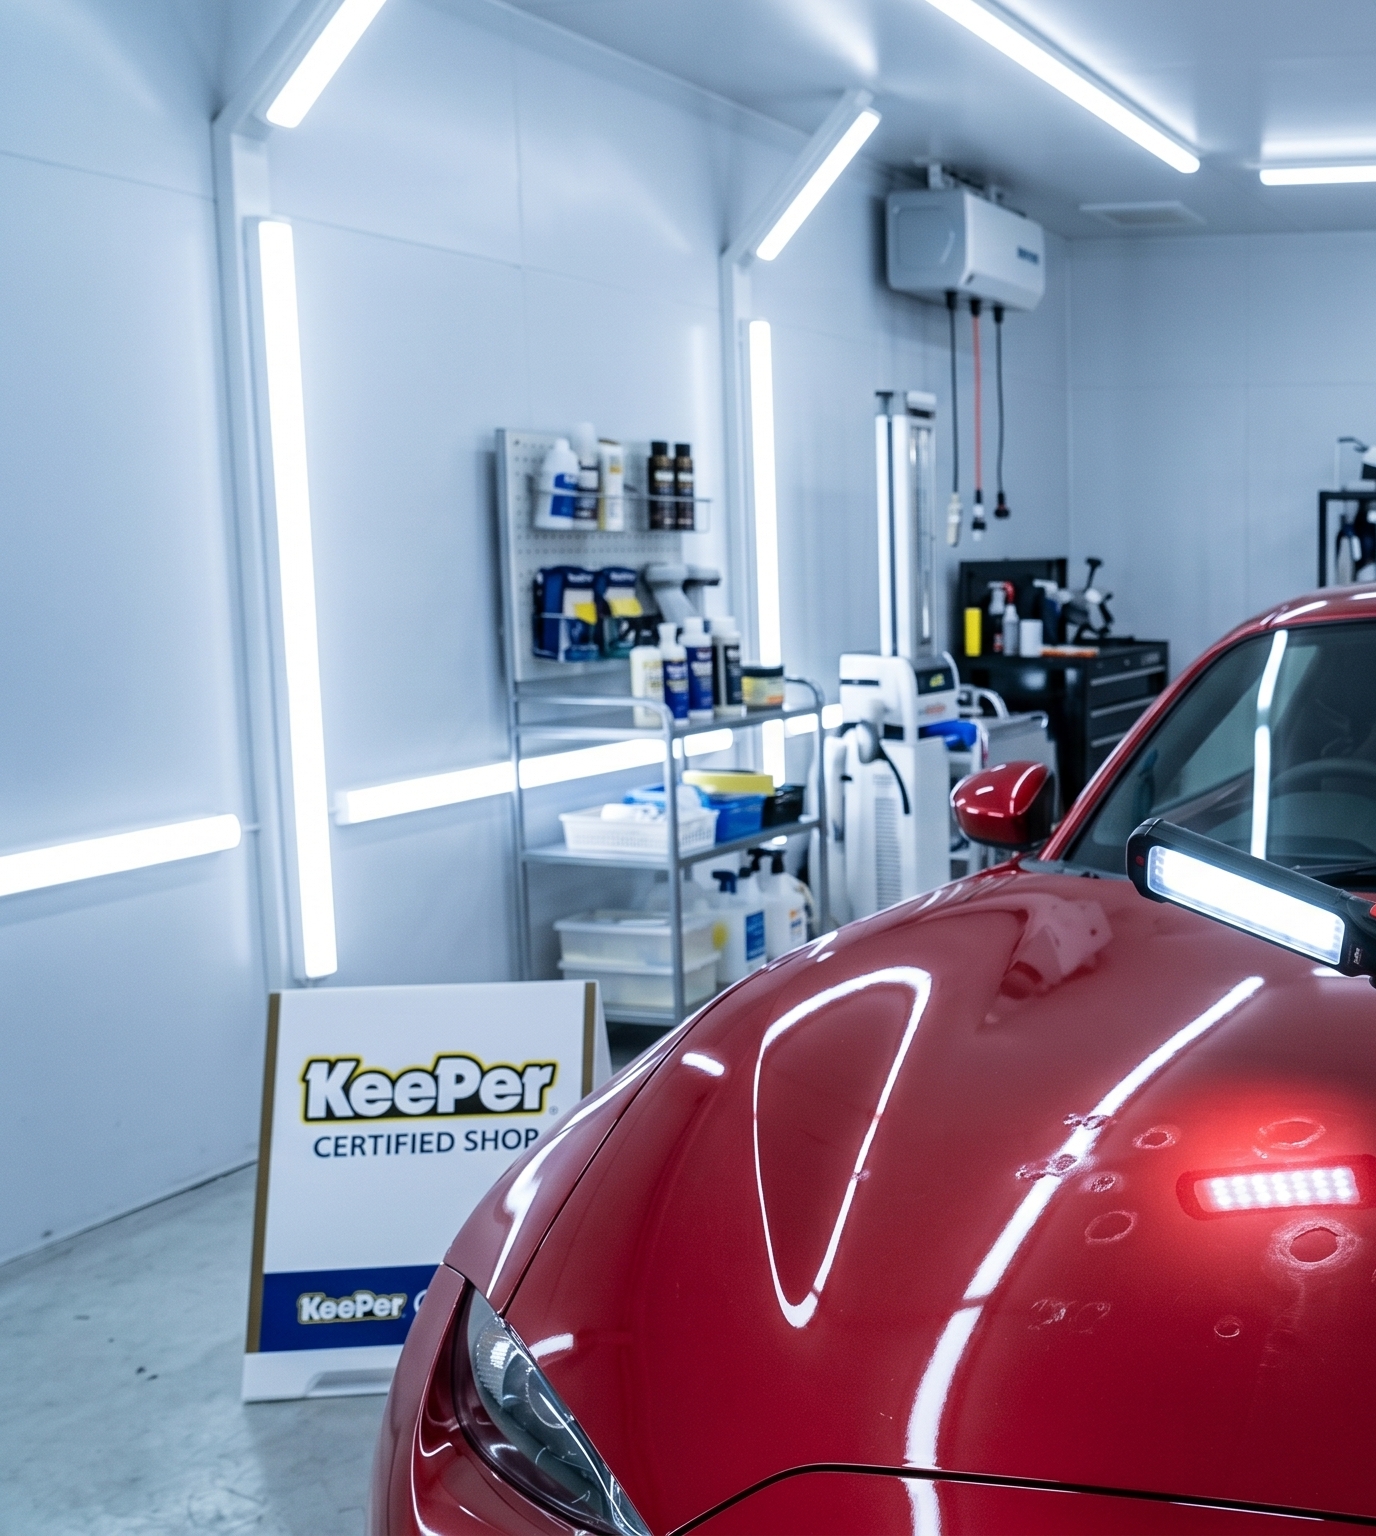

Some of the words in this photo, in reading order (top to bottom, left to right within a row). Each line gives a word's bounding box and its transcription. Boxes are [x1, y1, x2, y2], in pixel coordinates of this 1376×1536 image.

[303, 1055, 556, 1120] KeePer
[313, 1131, 456, 1159] CERTIFIED
[464, 1128, 539, 1152] SHOP
[299, 1292, 405, 1322] KeePer
